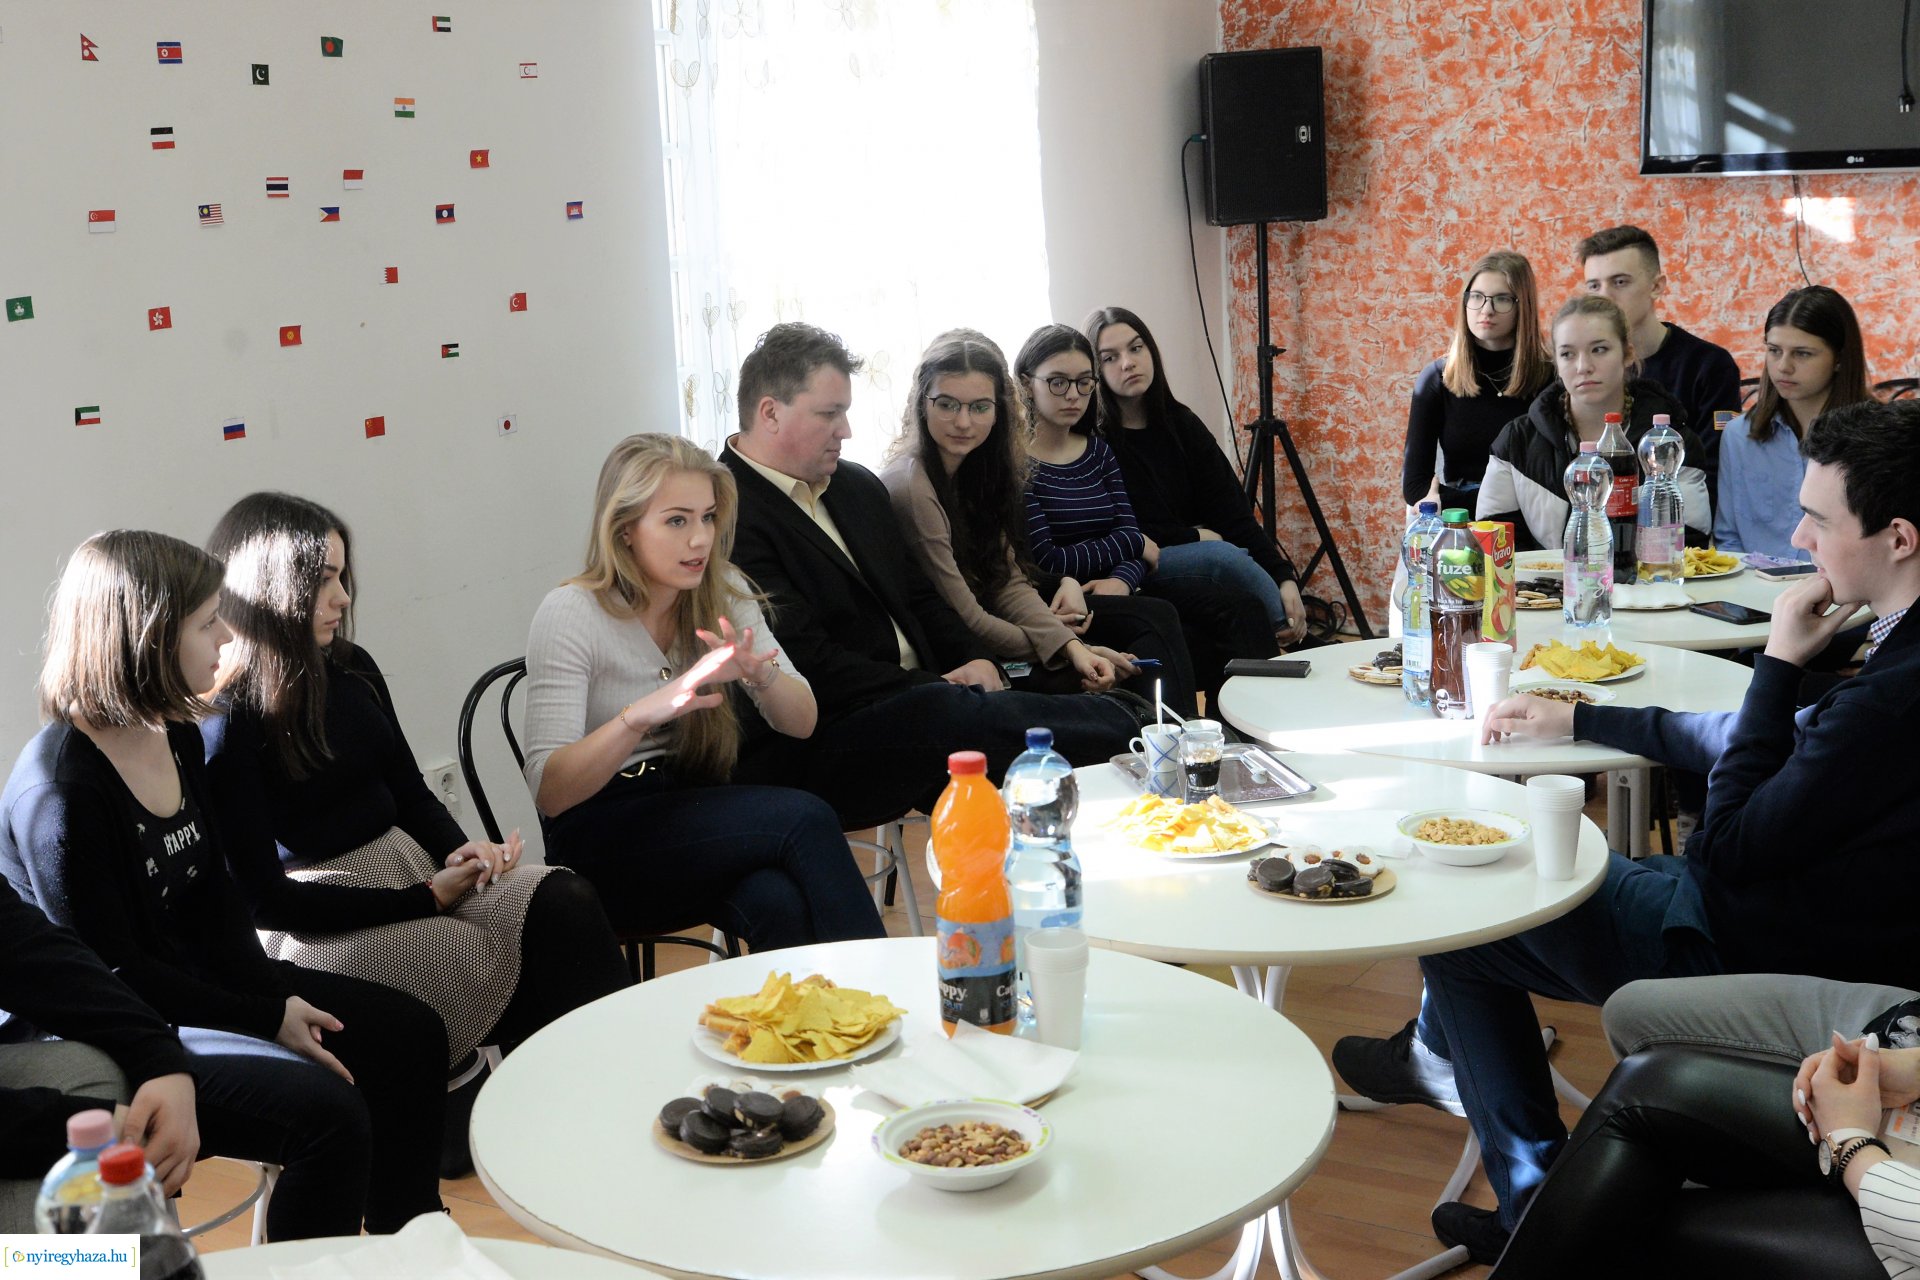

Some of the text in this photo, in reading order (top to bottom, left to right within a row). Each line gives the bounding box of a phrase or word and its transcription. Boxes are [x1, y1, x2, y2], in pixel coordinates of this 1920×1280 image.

[1493, 546, 1511, 562] bravo
[163, 821, 200, 856] HAPPY
[940, 983, 968, 1002] appy
